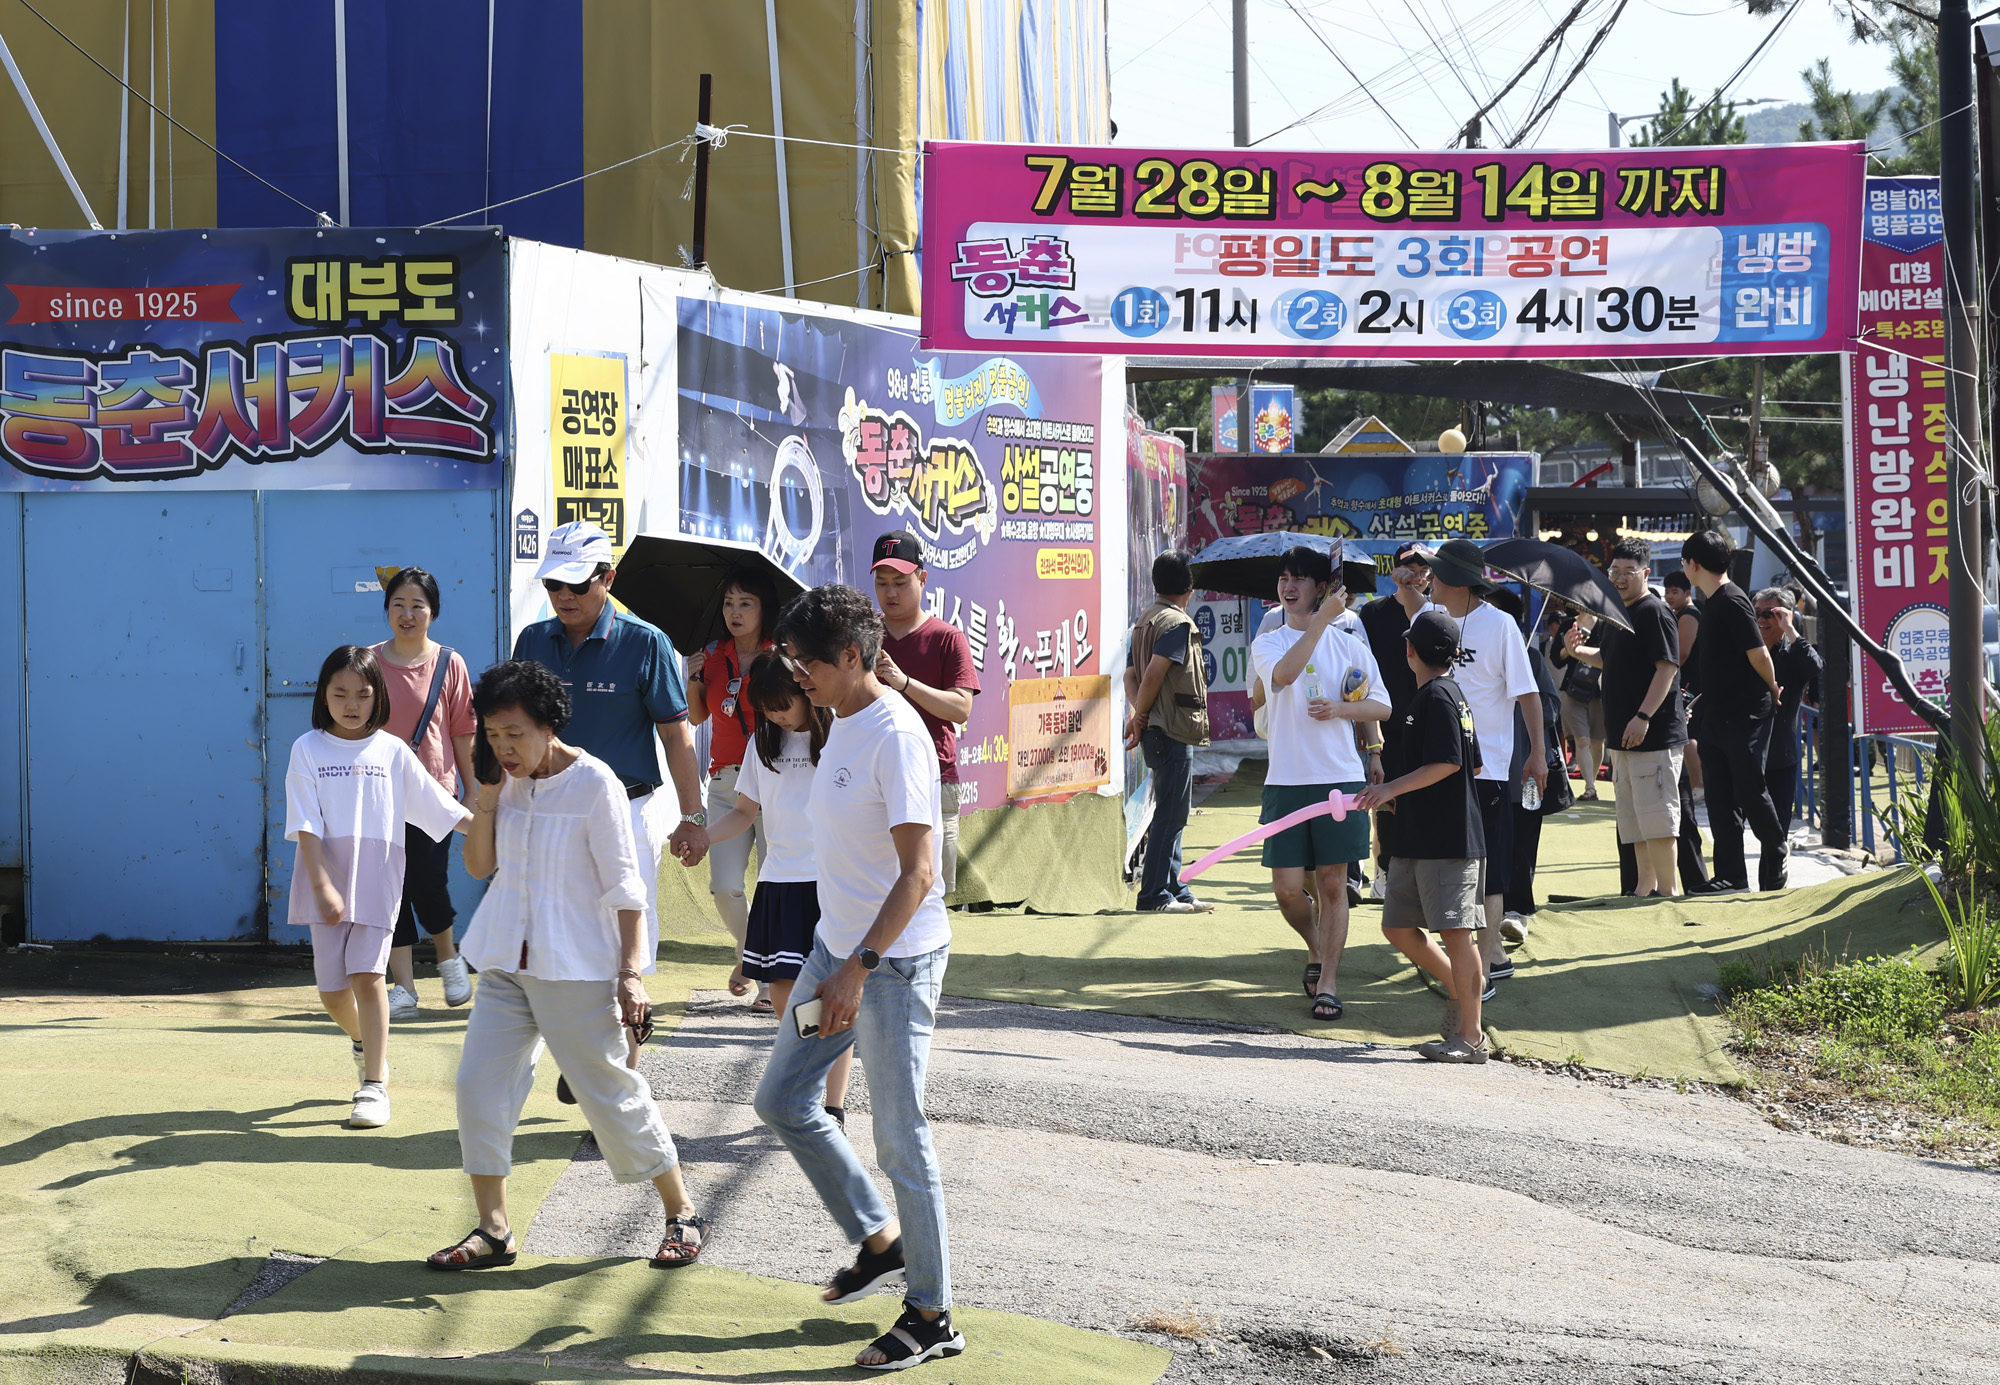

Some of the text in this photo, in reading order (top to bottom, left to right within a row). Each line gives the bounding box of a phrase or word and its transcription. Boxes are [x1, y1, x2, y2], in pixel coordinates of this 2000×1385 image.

[1025, 154, 1120, 216] 7월
[1132, 157, 1276, 220] 28일
[1360, 162, 1460, 222] 8월
[1473, 162, 1604, 221] 14일
[1615, 165, 1724, 218] 까지
[951, 236, 1075, 298] 동춘
[1219, 235, 1608, 278] 평일도 3회 공연
[1736, 231, 1817, 273] 냉방
[1889, 261, 1931, 285] 대형
[49, 292, 198, 318] since 1925
[289, 260, 458, 323] 대부도
[1119, 286, 1699, 334] 1회 11시 2회 2시 3회 4시 30분
[1735, 286, 1812, 328] 완비
[1860, 287, 1943, 312] 에어컨설
[984, 293, 1090, 334] 서커스
[0, 335, 490, 476] 동춘서커스
[887, 367, 932, 404] 98년 전통
[944, 363, 1031, 419] 명불허전! 명품공연!
[561, 388, 618, 437] 공연장
[562, 445, 620, 491] 매표소
[1001, 444, 1094, 517] 상설공연중
[1866, 352, 1917, 588] 냉난방완비
[1231, 486, 1268, 497] Since 1925
[1378, 496, 1402, 510] 초대형
[1404, 490, 1448, 506] 아트서커스로
[518, 533, 537, 554] 1426
[1057, 552, 1091, 576] 극장식의자
[1018, 749, 1029, 767] 대인
[1058, 745, 1069, 763] 소인
